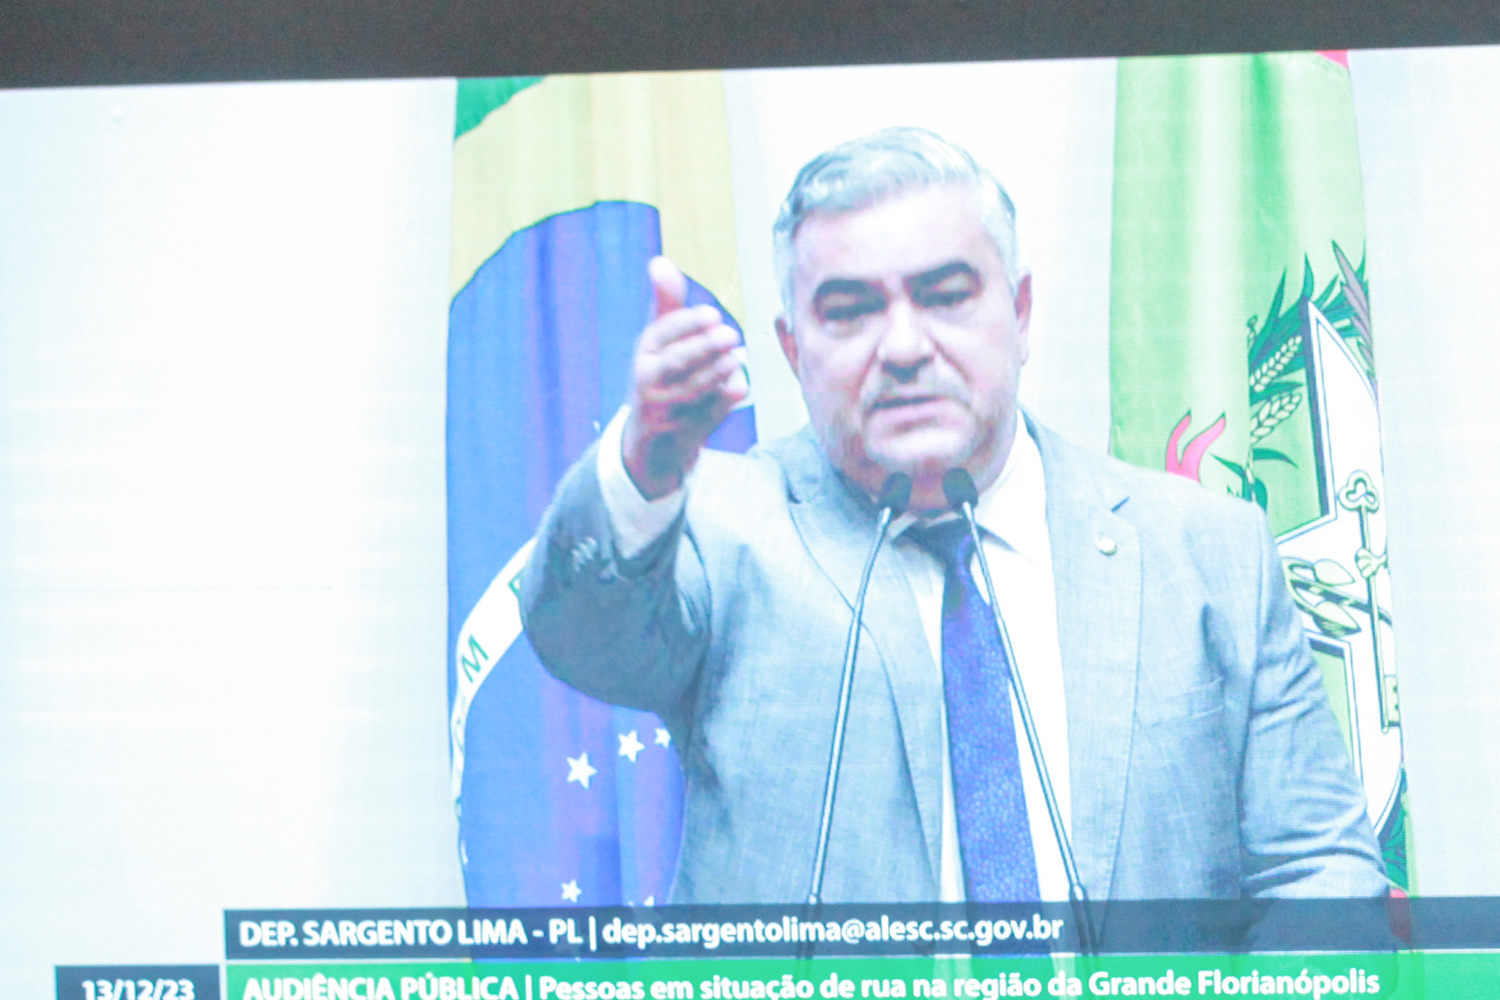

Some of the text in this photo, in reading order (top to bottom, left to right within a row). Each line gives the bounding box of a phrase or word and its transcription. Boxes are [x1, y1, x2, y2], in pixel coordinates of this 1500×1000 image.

[239, 920, 299, 946] DEP.
[302, 920, 453, 945] SARGENTO
[457, 919, 528, 945] LIMA
[549, 919, 584, 943] PL
[602, 914, 1064, 951] dep.sargentolima@alesc.sc.gov.br
[401, 972, 519, 1000] PÚBLICA
[539, 976, 646, 1000] Pessoas
[650, 981, 695, 1000] em
[819, 972, 856, 999] de
[861, 979, 907, 998] rua
[913, 977, 948, 998] na
[1047, 970, 1083, 997] da
[1088, 969, 1192, 996] Grande
[1198, 968, 1380, 1000] Florianópolis
